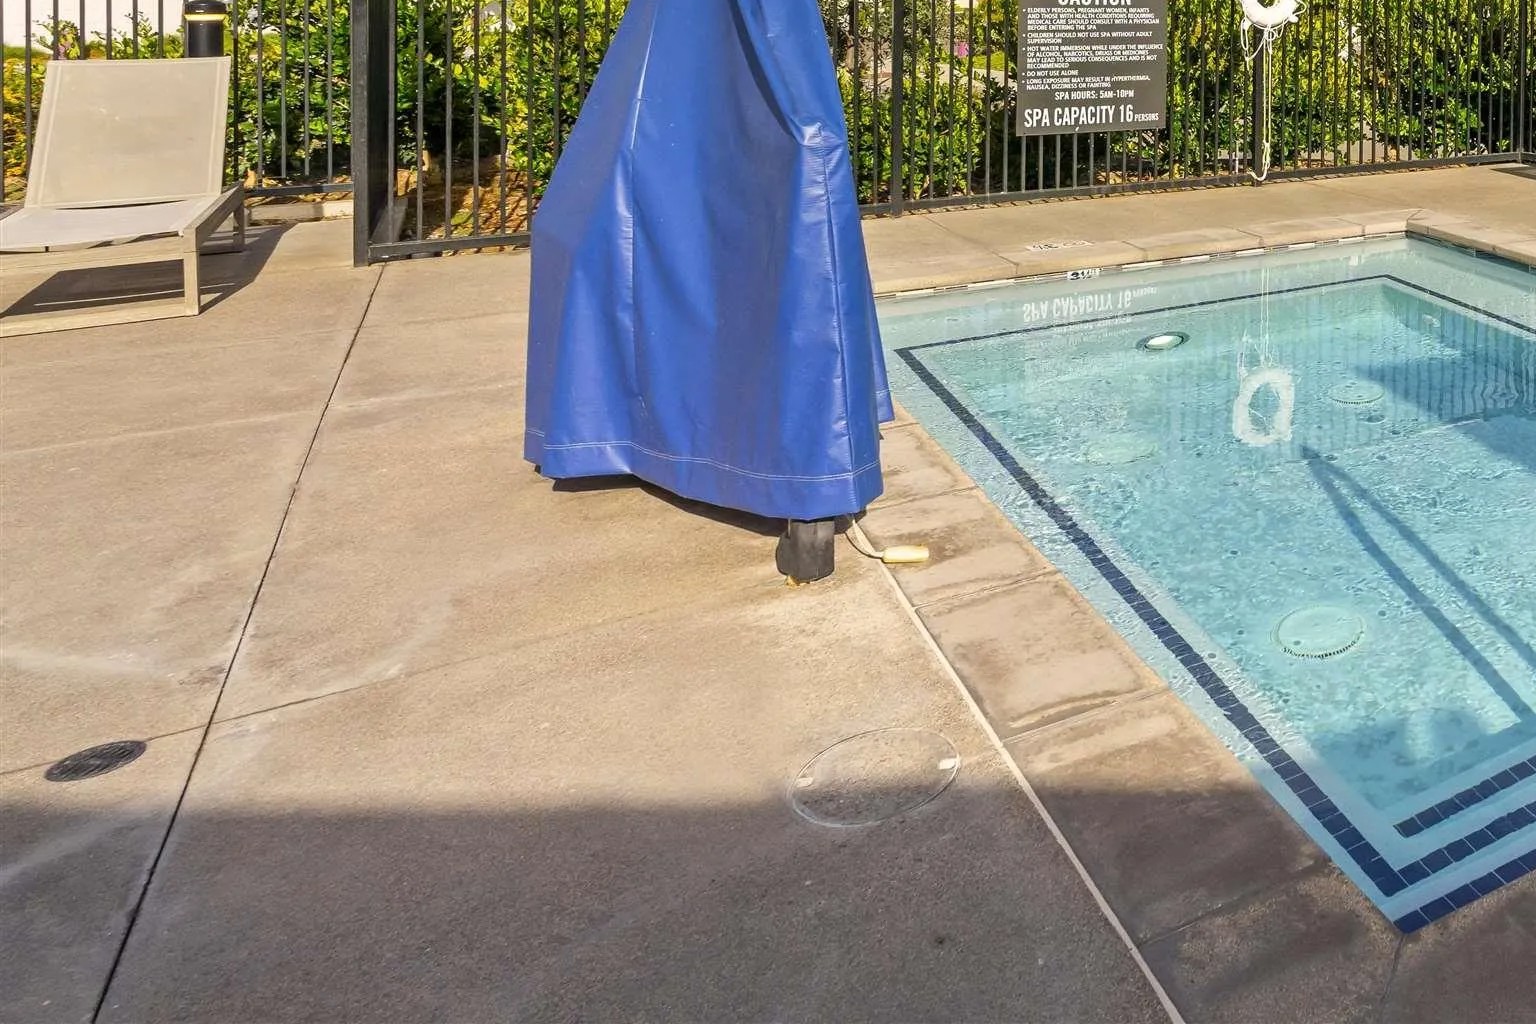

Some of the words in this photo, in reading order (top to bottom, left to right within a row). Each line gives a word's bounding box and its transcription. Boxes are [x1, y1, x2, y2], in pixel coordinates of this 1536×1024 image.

[1055, 92, 1069, 100] SPA
[1071, 91, 1098, 100] HOURS:
[1100, 90, 1134, 98] 5AM-10PM
[1024, 108, 1050, 127] SPA
[1054, 105, 1114, 126] CAPACITY
[1120, 105, 1133, 122] 16
[1134, 113, 1159, 121] PERSONS
